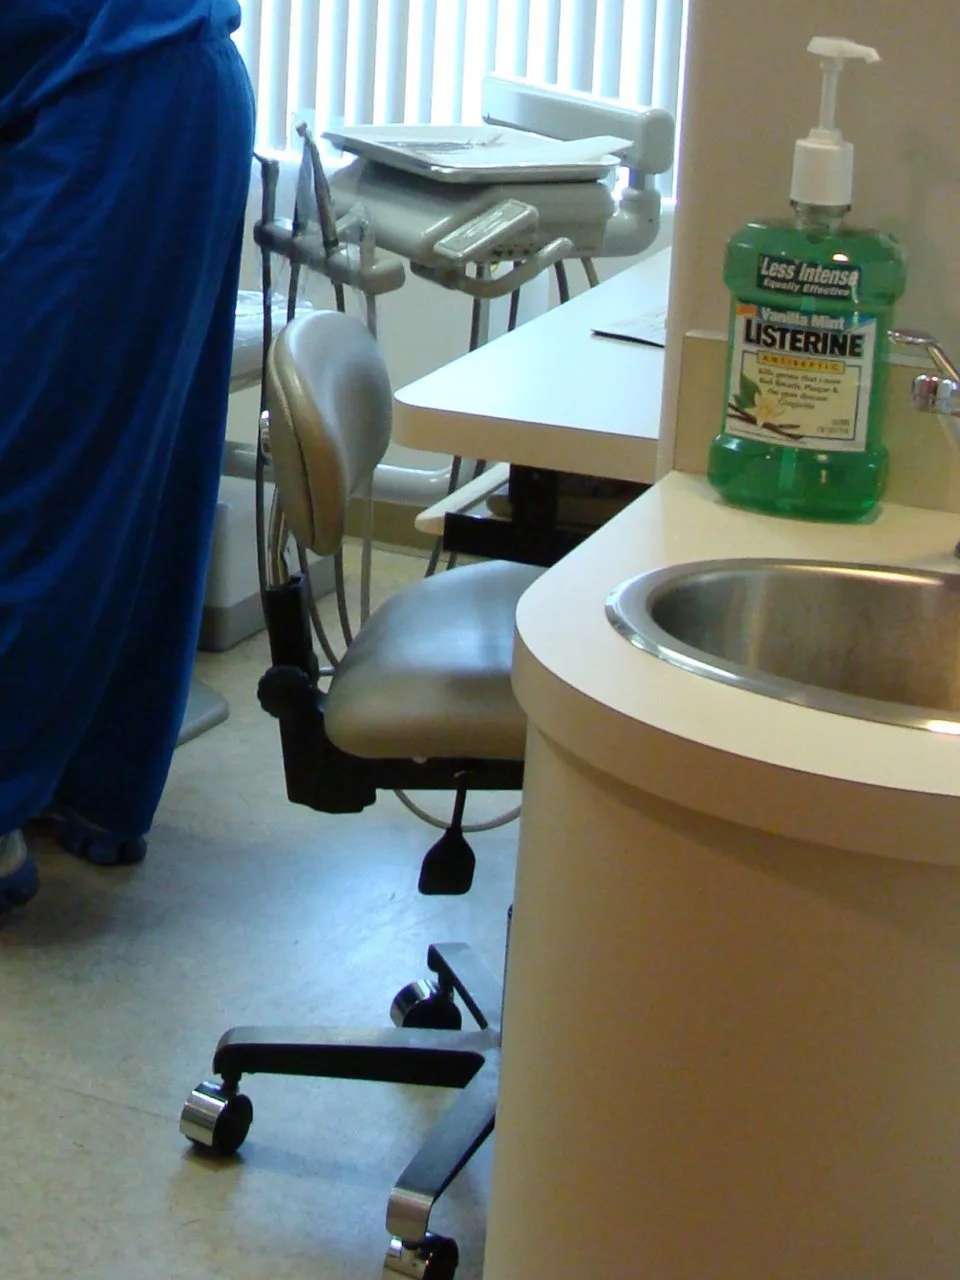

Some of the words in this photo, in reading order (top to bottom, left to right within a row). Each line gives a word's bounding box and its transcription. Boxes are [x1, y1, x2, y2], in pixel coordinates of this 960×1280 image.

[761, 257, 796, 280] Less
[798, 262, 859, 286] Intense
[763, 278, 800, 293] Equally
[802, 283, 850, 297] Effective
[761, 307, 808, 325] Vanilla
[811, 313, 845, 331] Mint
[744, 318, 865, 357] LISTERINE
